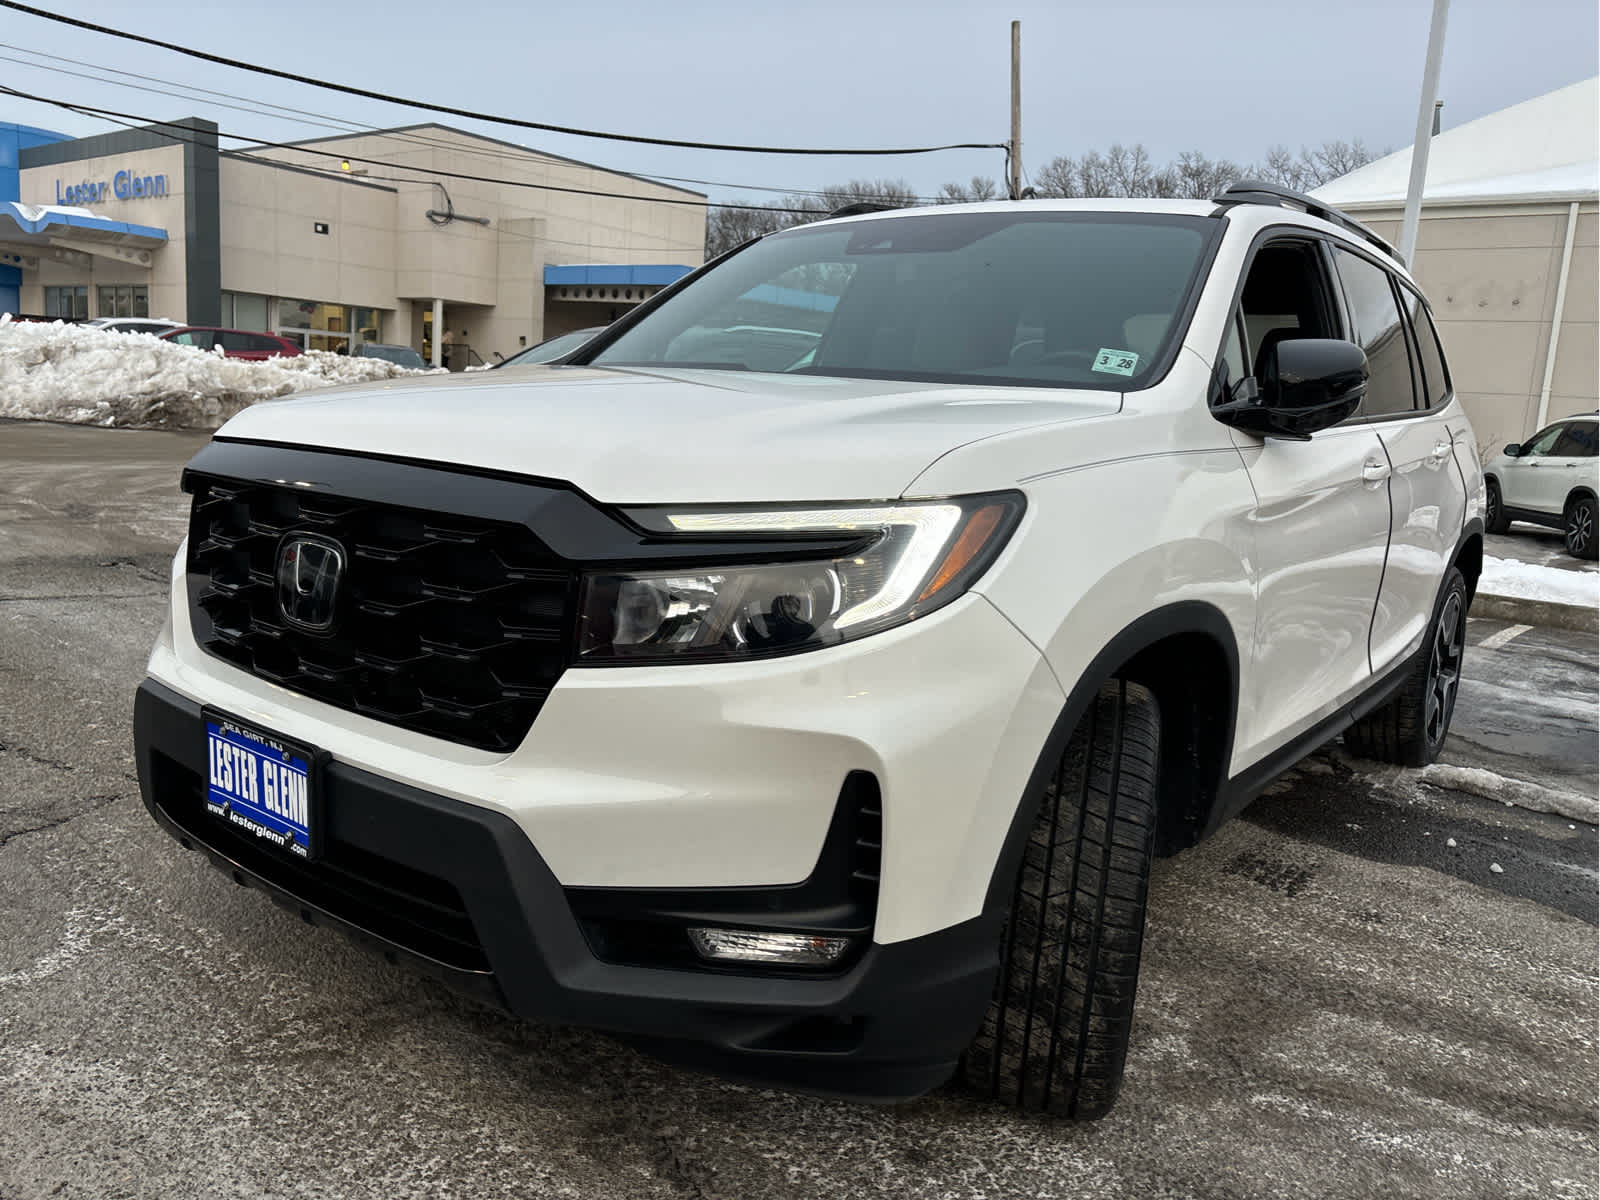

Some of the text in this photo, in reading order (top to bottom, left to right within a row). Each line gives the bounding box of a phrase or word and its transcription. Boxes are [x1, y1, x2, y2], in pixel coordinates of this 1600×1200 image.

[56, 169, 166, 206] Lester Glenn
[1100, 356, 1133, 369] 3 28
[223, 721, 242, 736] SEA
[209, 736, 309, 828] LESTER GLENN
[229, 810, 285, 846] lesterglenn
